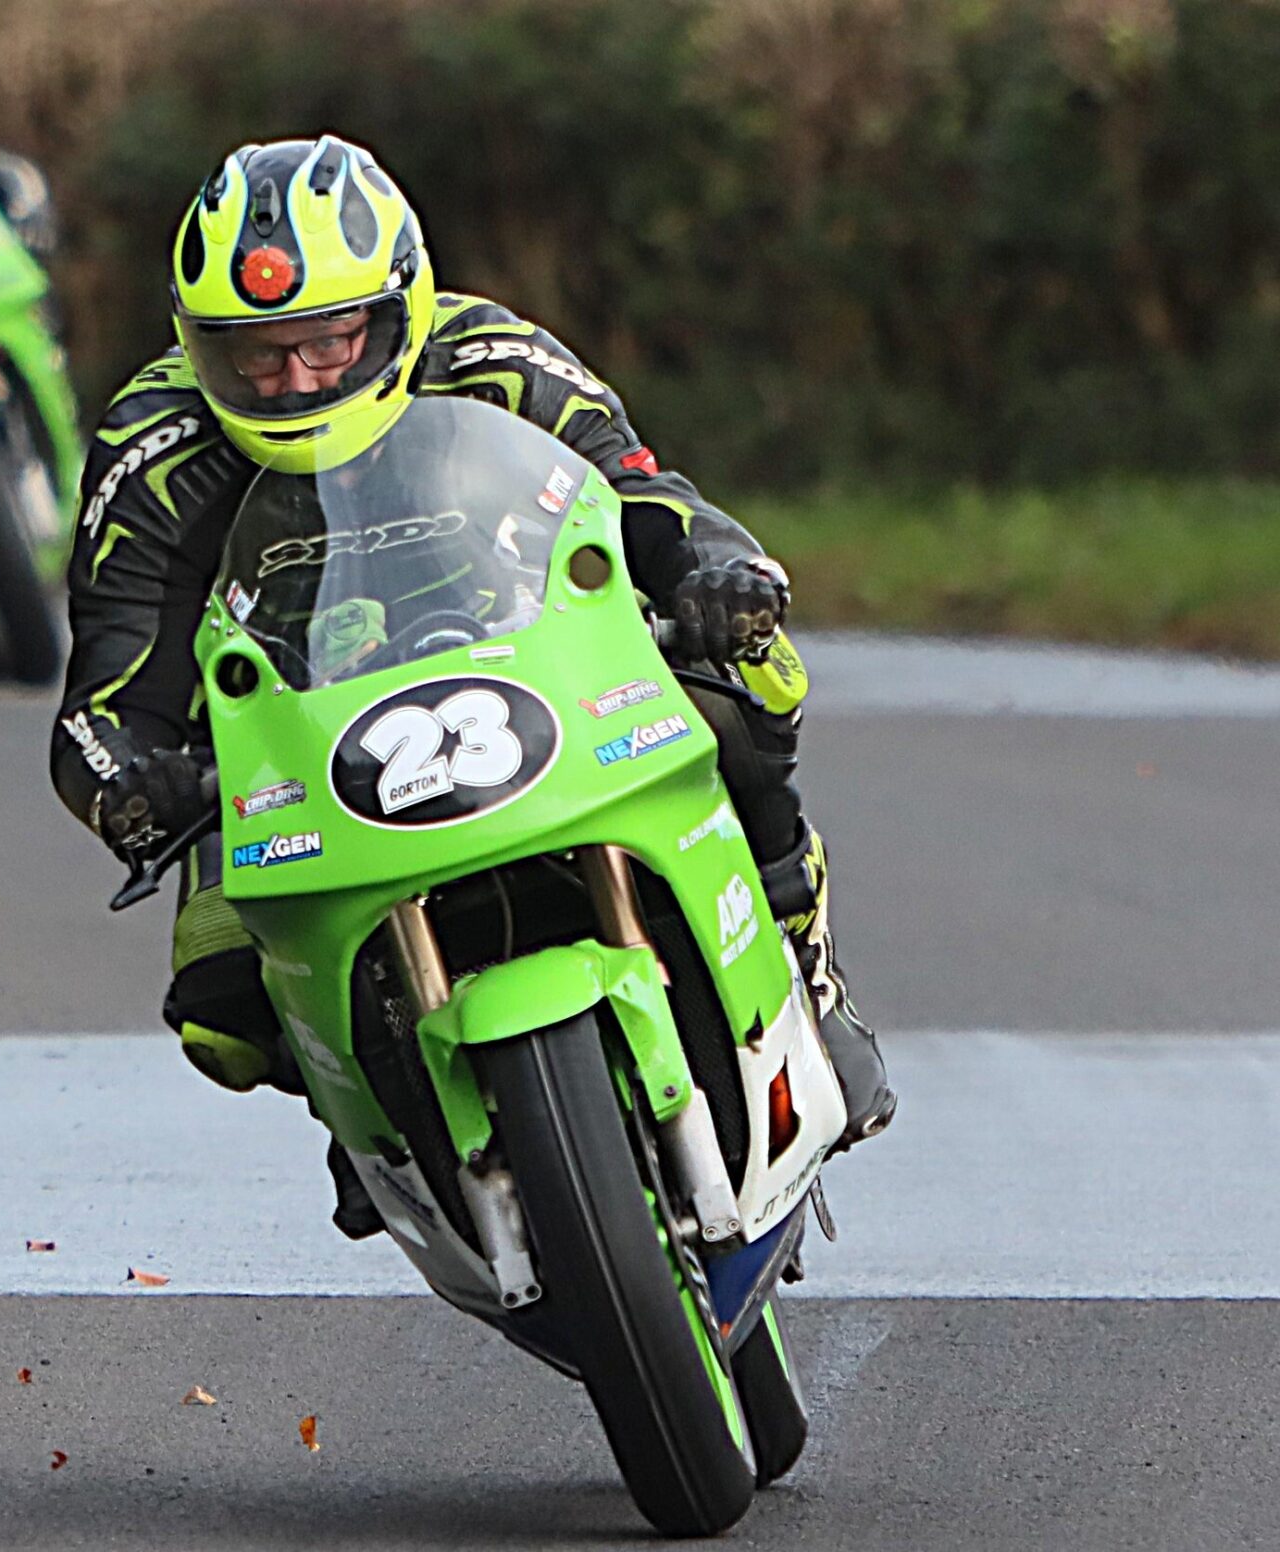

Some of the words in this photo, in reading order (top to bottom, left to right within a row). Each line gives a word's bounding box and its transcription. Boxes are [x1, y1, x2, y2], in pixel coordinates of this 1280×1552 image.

[450, 341, 605, 395] SPIDI
[82, 416, 200, 540] SPIDI
[257, 510, 467, 578] SPIDI
[61, 710, 120, 781] SPIDI
[360, 688, 523, 815] 23
[594, 713, 689, 765] NEXGEN
[389, 774, 439, 801] GORTON
[233, 831, 321, 867] NEXGEN
[754, 1194, 779, 1224] JT
